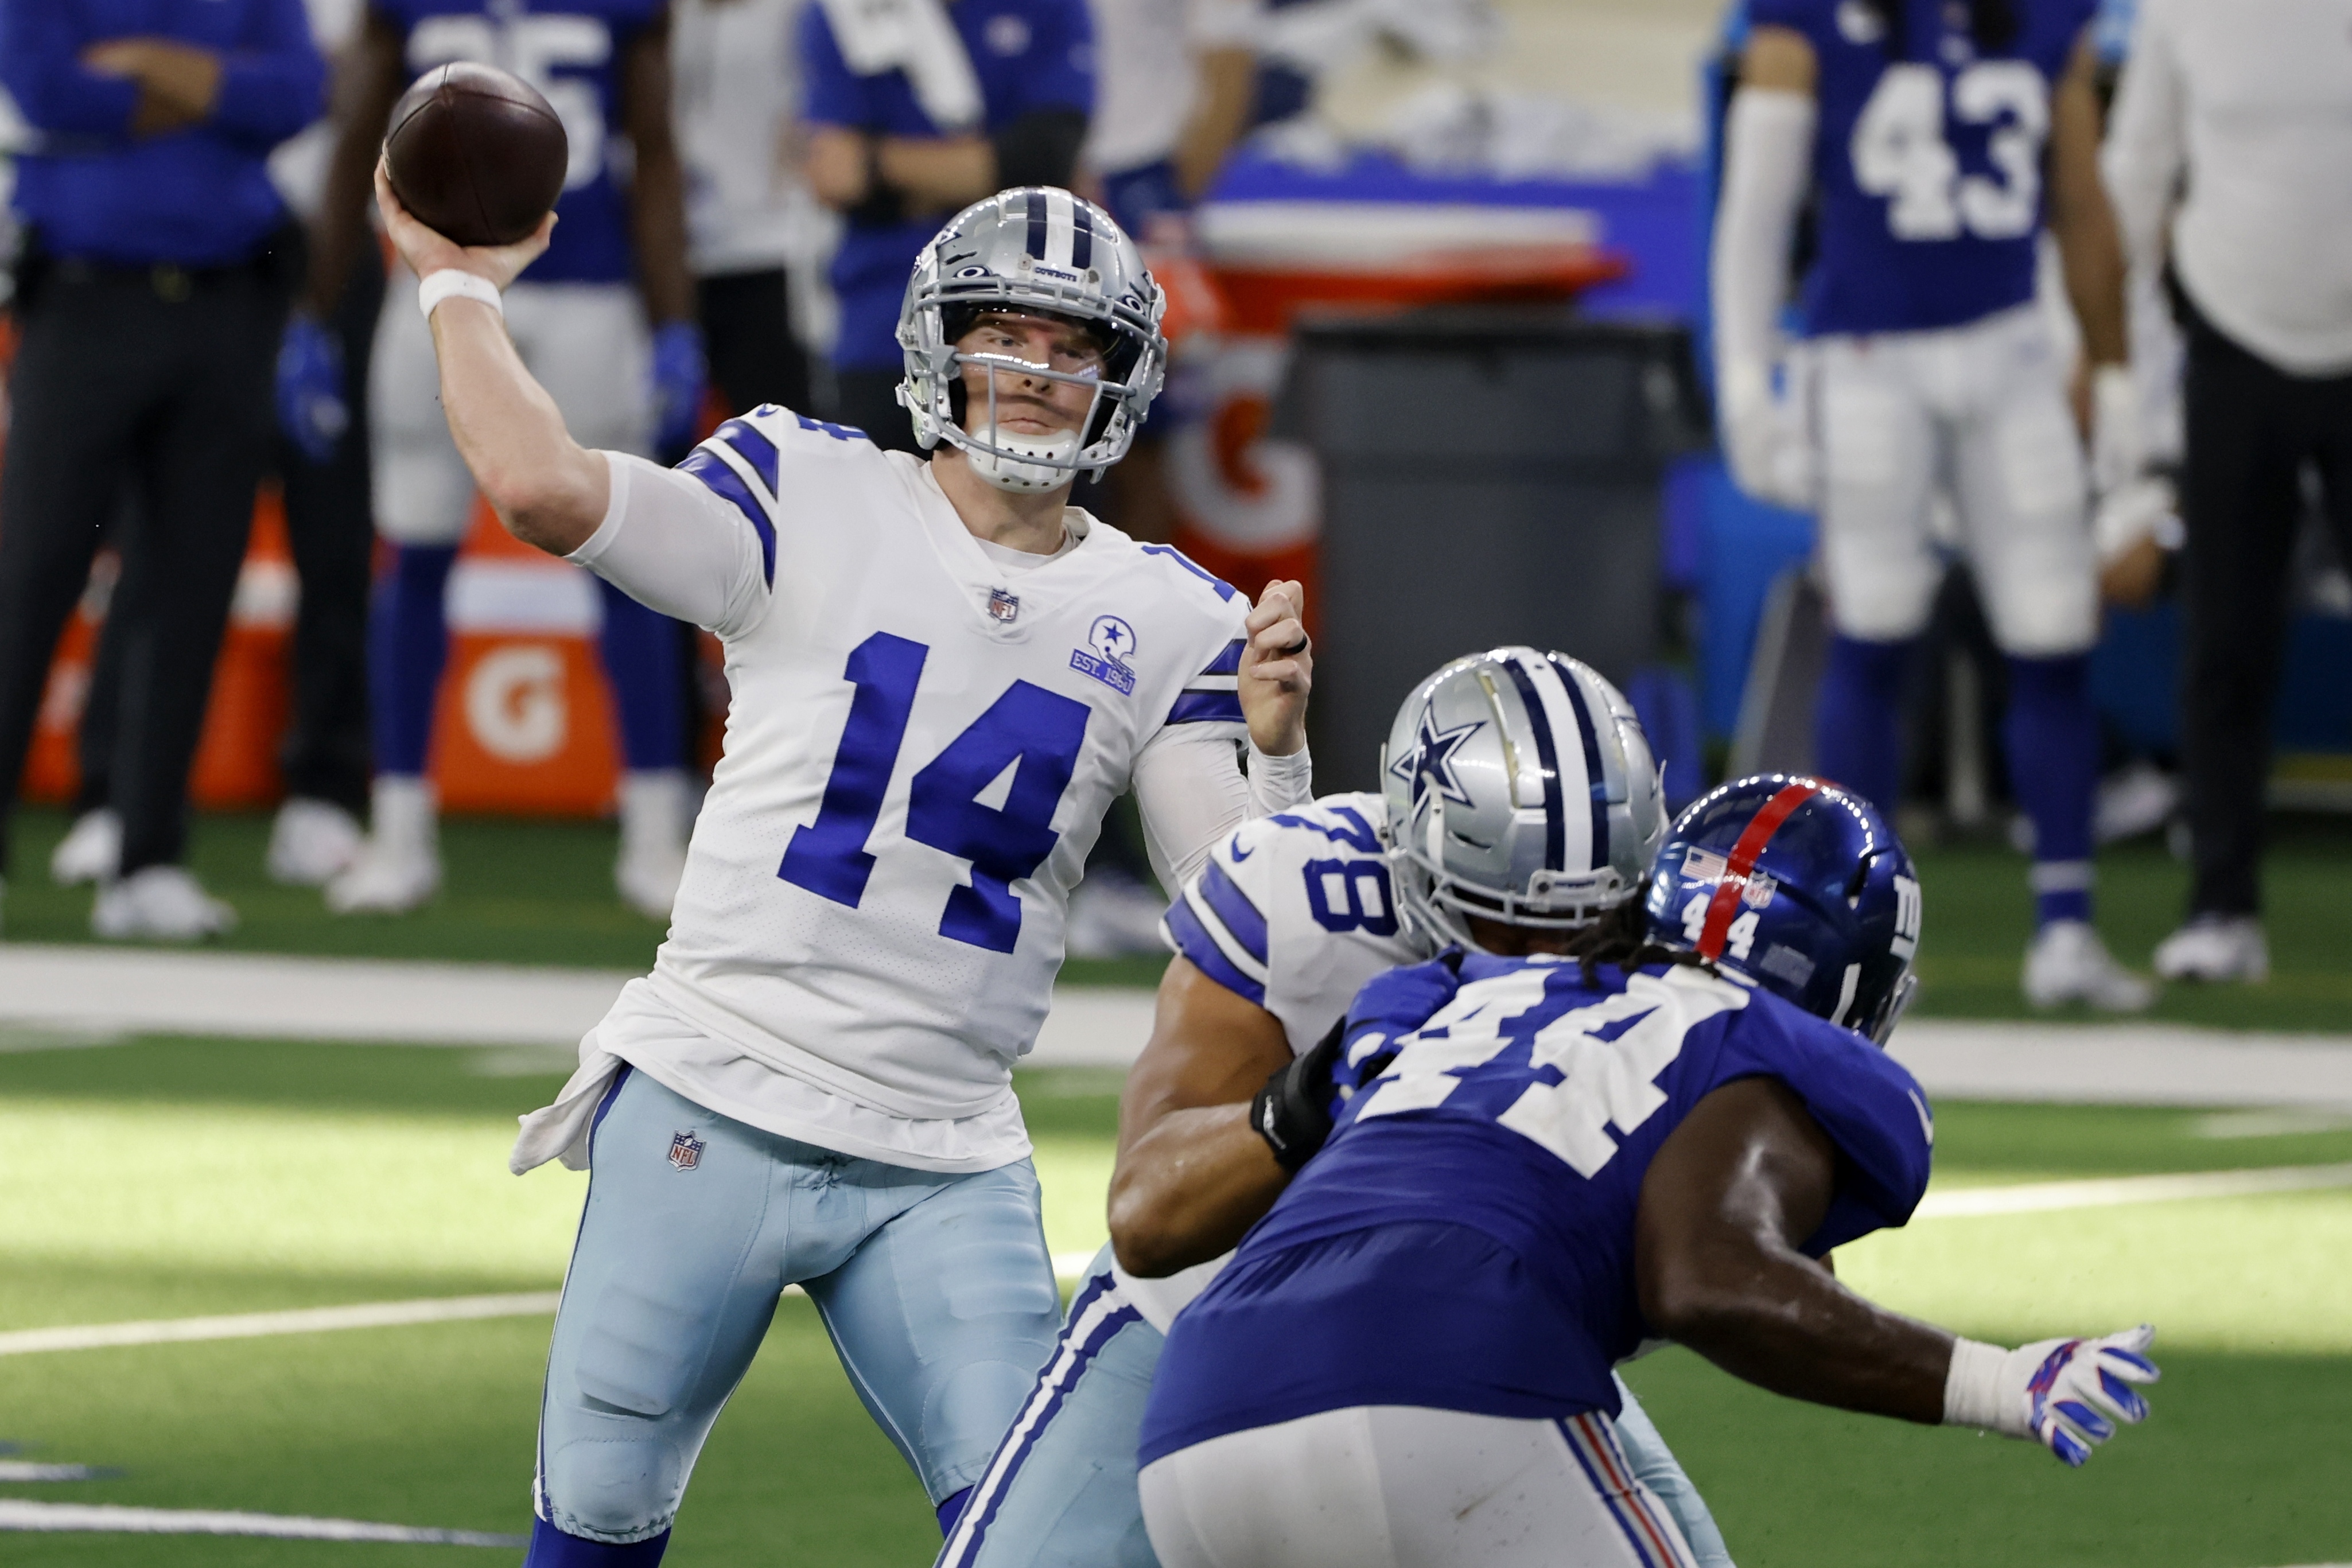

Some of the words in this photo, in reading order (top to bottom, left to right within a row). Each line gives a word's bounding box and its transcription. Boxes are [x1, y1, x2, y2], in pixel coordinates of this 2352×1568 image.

[1850, 59, 2050, 241] 43
[1034, 266, 1078, 282] COWBOYS
[465, 645, 567, 765] G
[1072, 652, 1101, 677] EST.
[776, 631, 1093, 955] 14
[1266, 806, 1399, 937] 78
[1355, 964, 1751, 1180] 44
[671, 1145, 695, 1165] NFL
